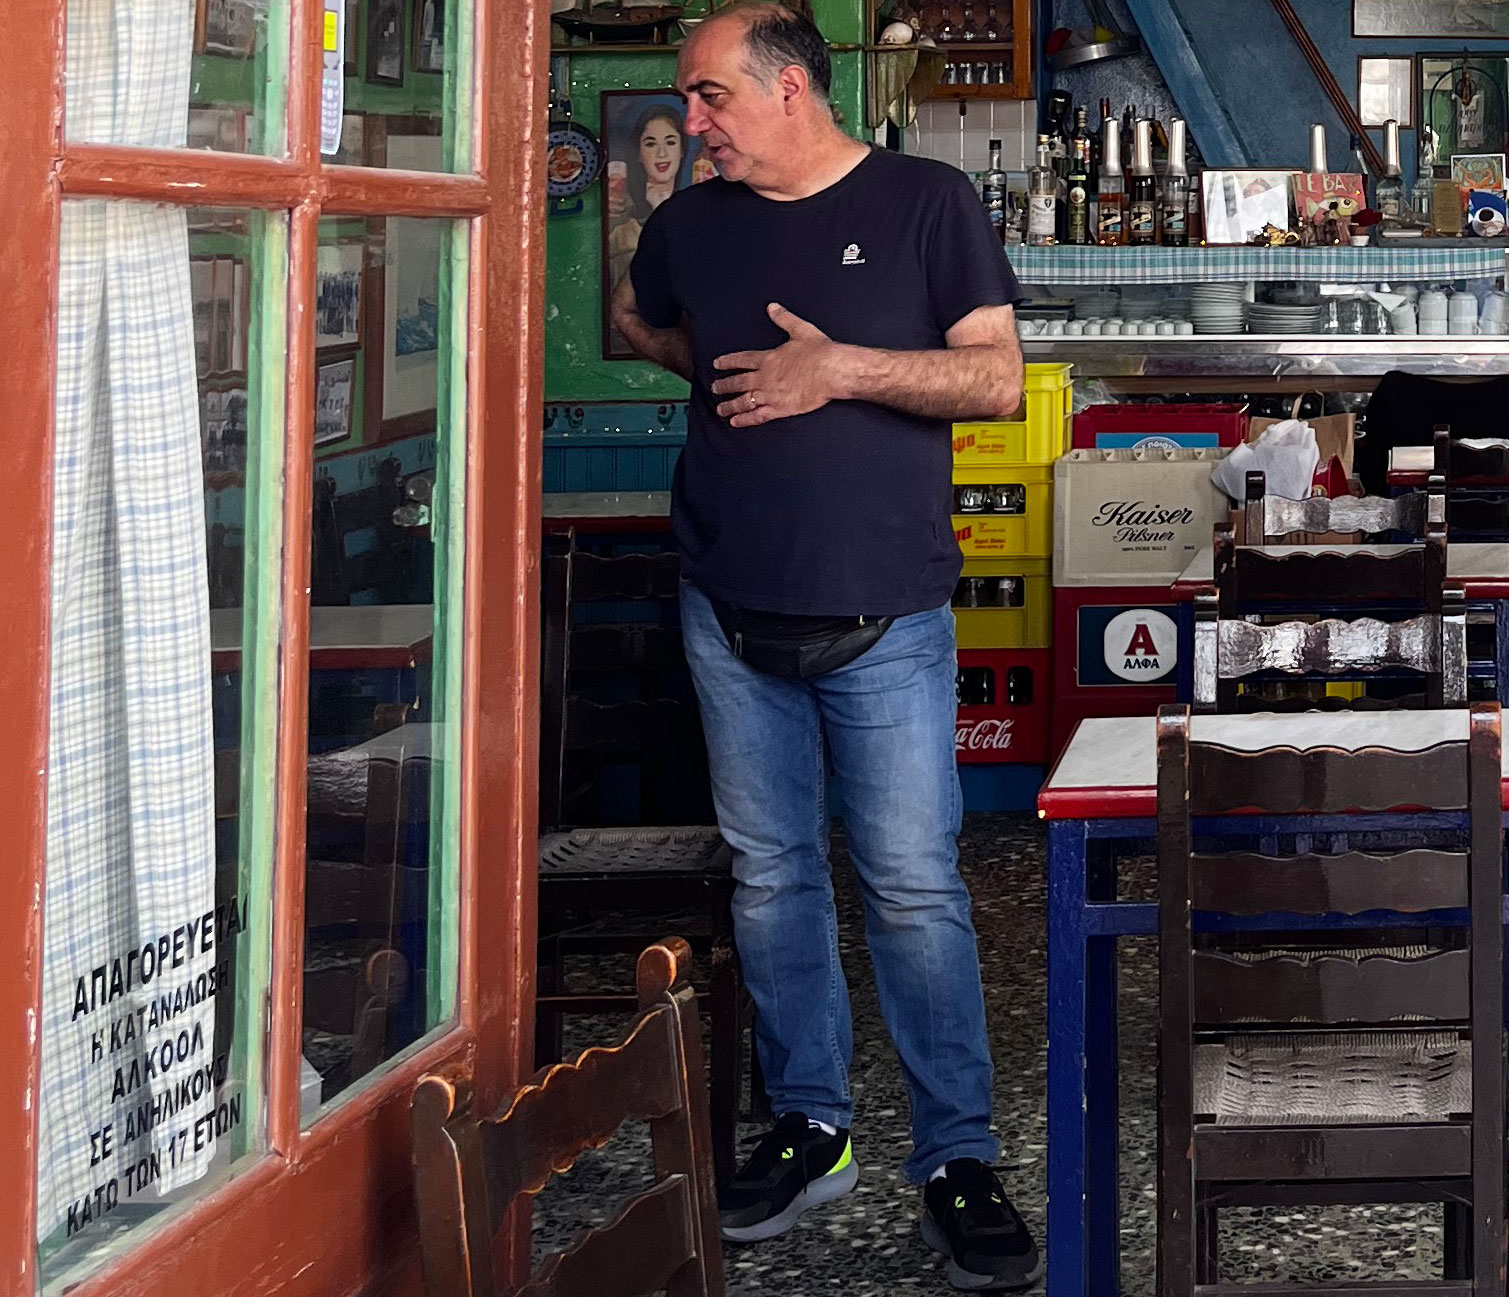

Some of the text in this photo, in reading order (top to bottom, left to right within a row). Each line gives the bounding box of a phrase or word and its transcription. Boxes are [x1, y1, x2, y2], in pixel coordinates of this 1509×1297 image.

[1091, 500, 1194, 527] Kaiser
[1112, 527, 1176, 543] Pilsner
[1123, 657, 1160, 670] ΑΛΦΑ
[955, 718, 1015, 751] a-Cola
[72, 892, 249, 1023] ΑΠΑΓΟΡΕΥΕΤΑΙ
[91, 958, 229, 1065] Η ΚΑΤΑΝΑΛΩΣΗ
[110, 1020, 205, 1105] ΑΛΚΟΟΛ
[89, 1054, 227, 1169] ΣΕ ΑΝΗΛΙΚΟΥΣ
[66, 1092, 242, 1238] ΚΑΤΩ ΤΩΝ 17 ΕΤΩΝ
